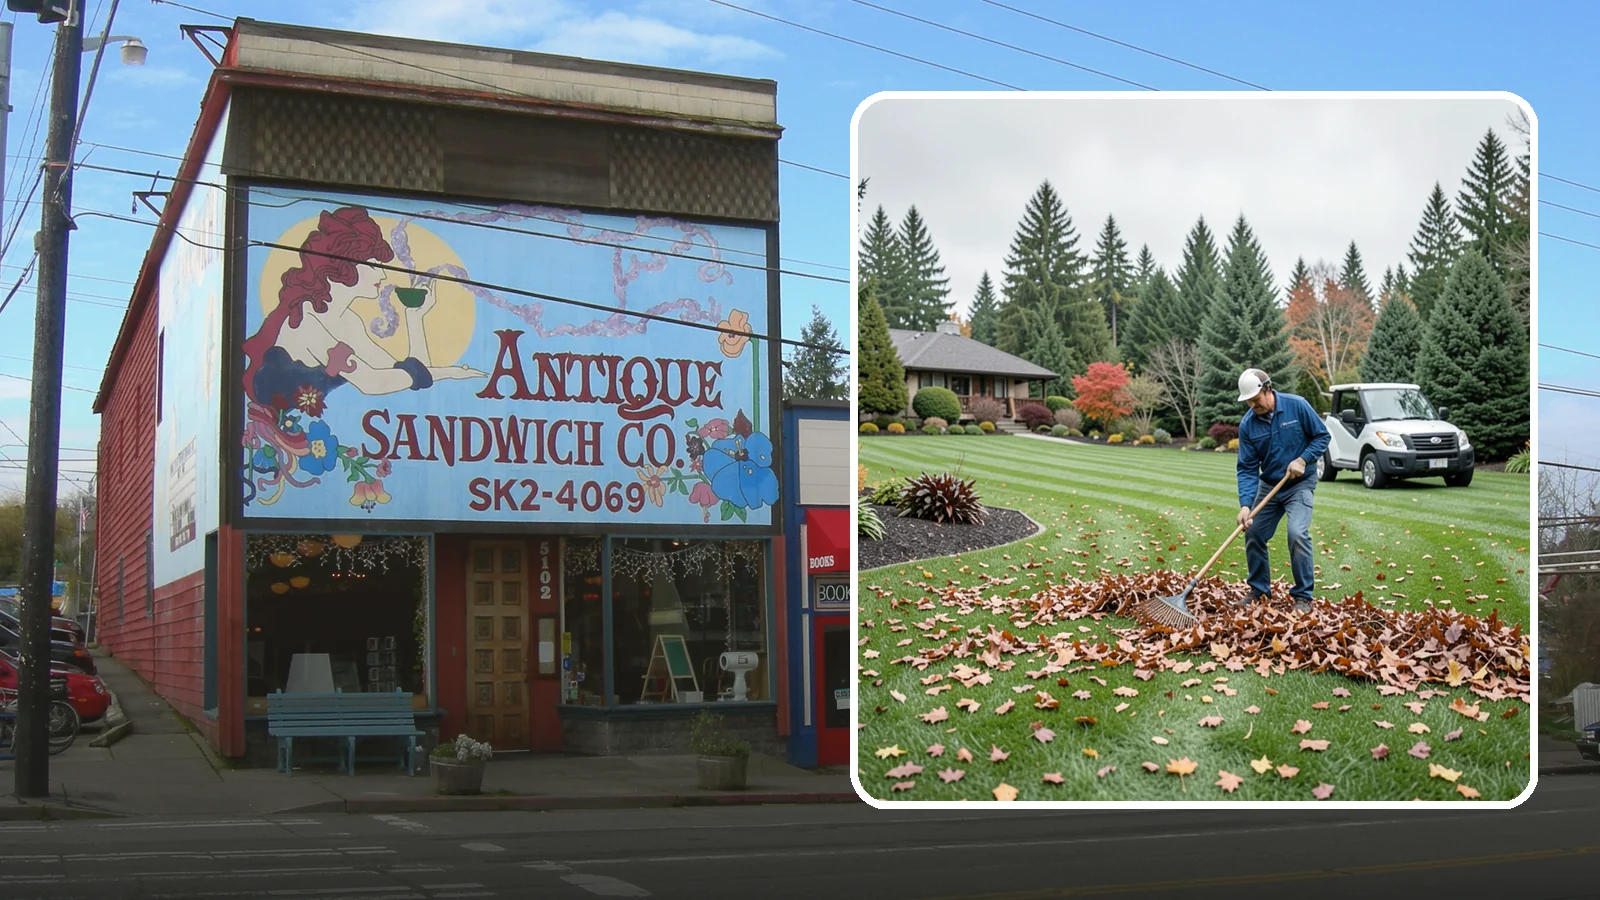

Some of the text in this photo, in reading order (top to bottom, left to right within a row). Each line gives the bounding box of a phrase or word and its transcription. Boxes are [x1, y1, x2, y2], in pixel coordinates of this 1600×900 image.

[475, 329, 723, 421] ANTIQUE
[361, 408, 685, 469] SANDWICH CO.
[468, 477, 645, 513] SK2-4069
[540, 541, 551, 600] 5102
[809, 555, 835, 569] BOOKS
